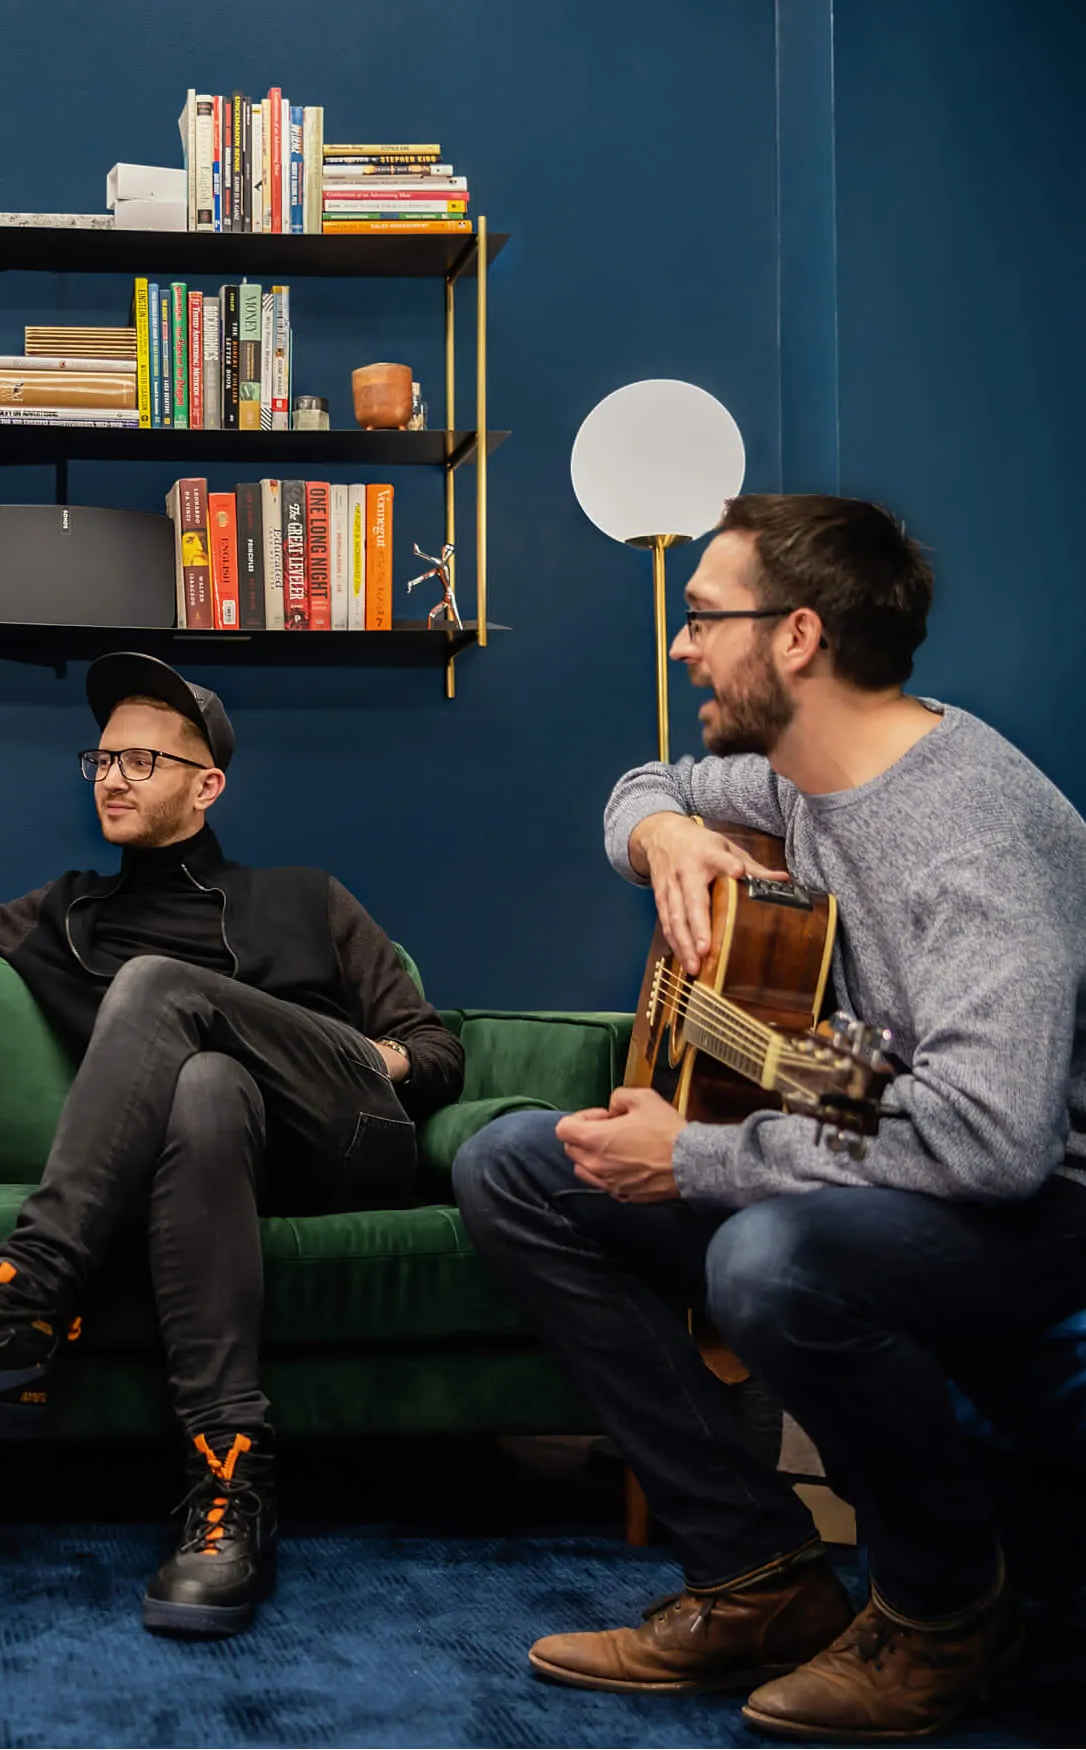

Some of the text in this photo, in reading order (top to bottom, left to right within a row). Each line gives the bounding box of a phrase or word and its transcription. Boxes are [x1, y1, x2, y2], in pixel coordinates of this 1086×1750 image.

[138, 289, 146, 318] EINSTEIN
[245, 295, 259, 334] MONEY
[185, 491, 190, 502] DA
[289, 503, 300, 520] The
[310, 488, 326, 515] ONE
[310, 519, 327, 553] LONG
[373, 490, 390, 547] Vonnegut
[288, 522, 303, 555] GREAT
[221, 538, 230, 583] ENGLISH
[273, 528, 283, 589] Educated
[288, 556, 304, 600] LEVELER
[310, 557, 328, 599] NIGHT
